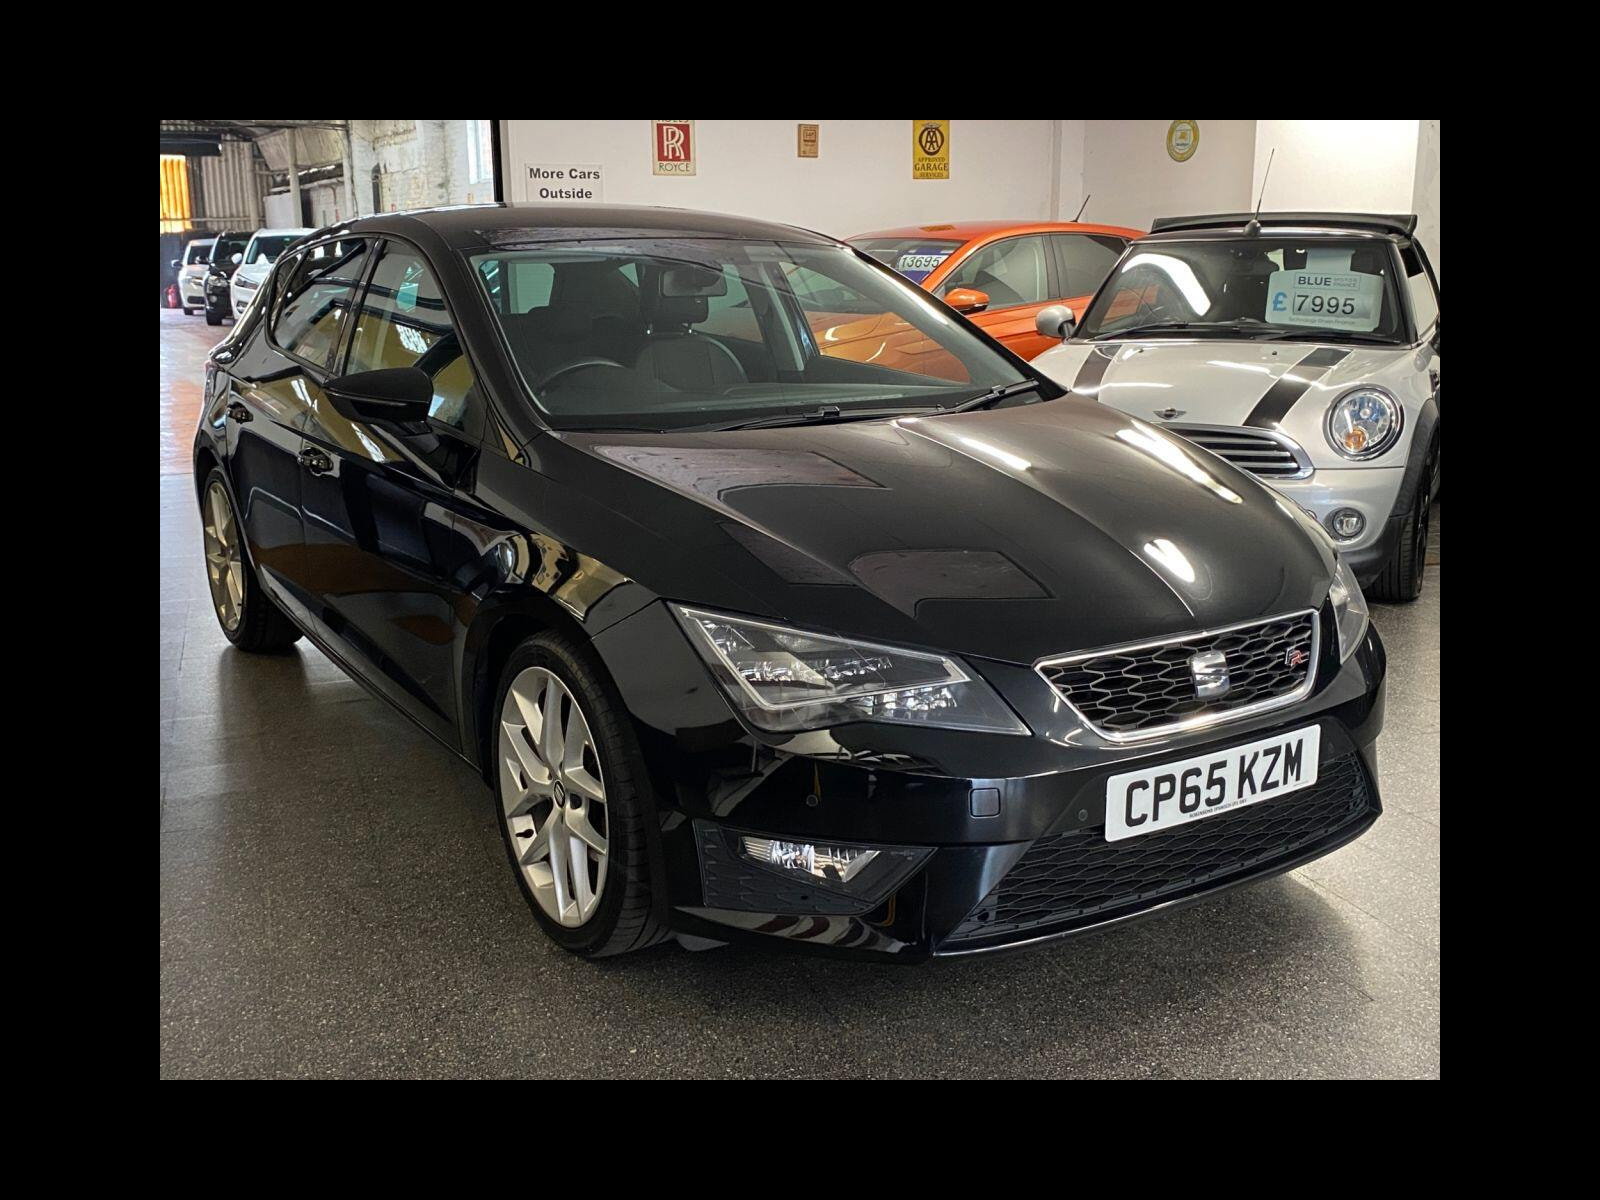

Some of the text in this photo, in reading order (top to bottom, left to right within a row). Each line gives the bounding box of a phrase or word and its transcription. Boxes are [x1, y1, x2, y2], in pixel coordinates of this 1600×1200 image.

[658, 162, 691, 172] ROYCE
[914, 163, 949, 172] GARAGE
[529, 168, 600, 179] More Cars
[539, 188, 593, 199] Outside
[902, 256, 942, 268] 13695
[1298, 276, 1332, 287] BLUE
[1272, 291, 1355, 315] £ 7995
[1125, 738, 1304, 828] CP65 KZM
